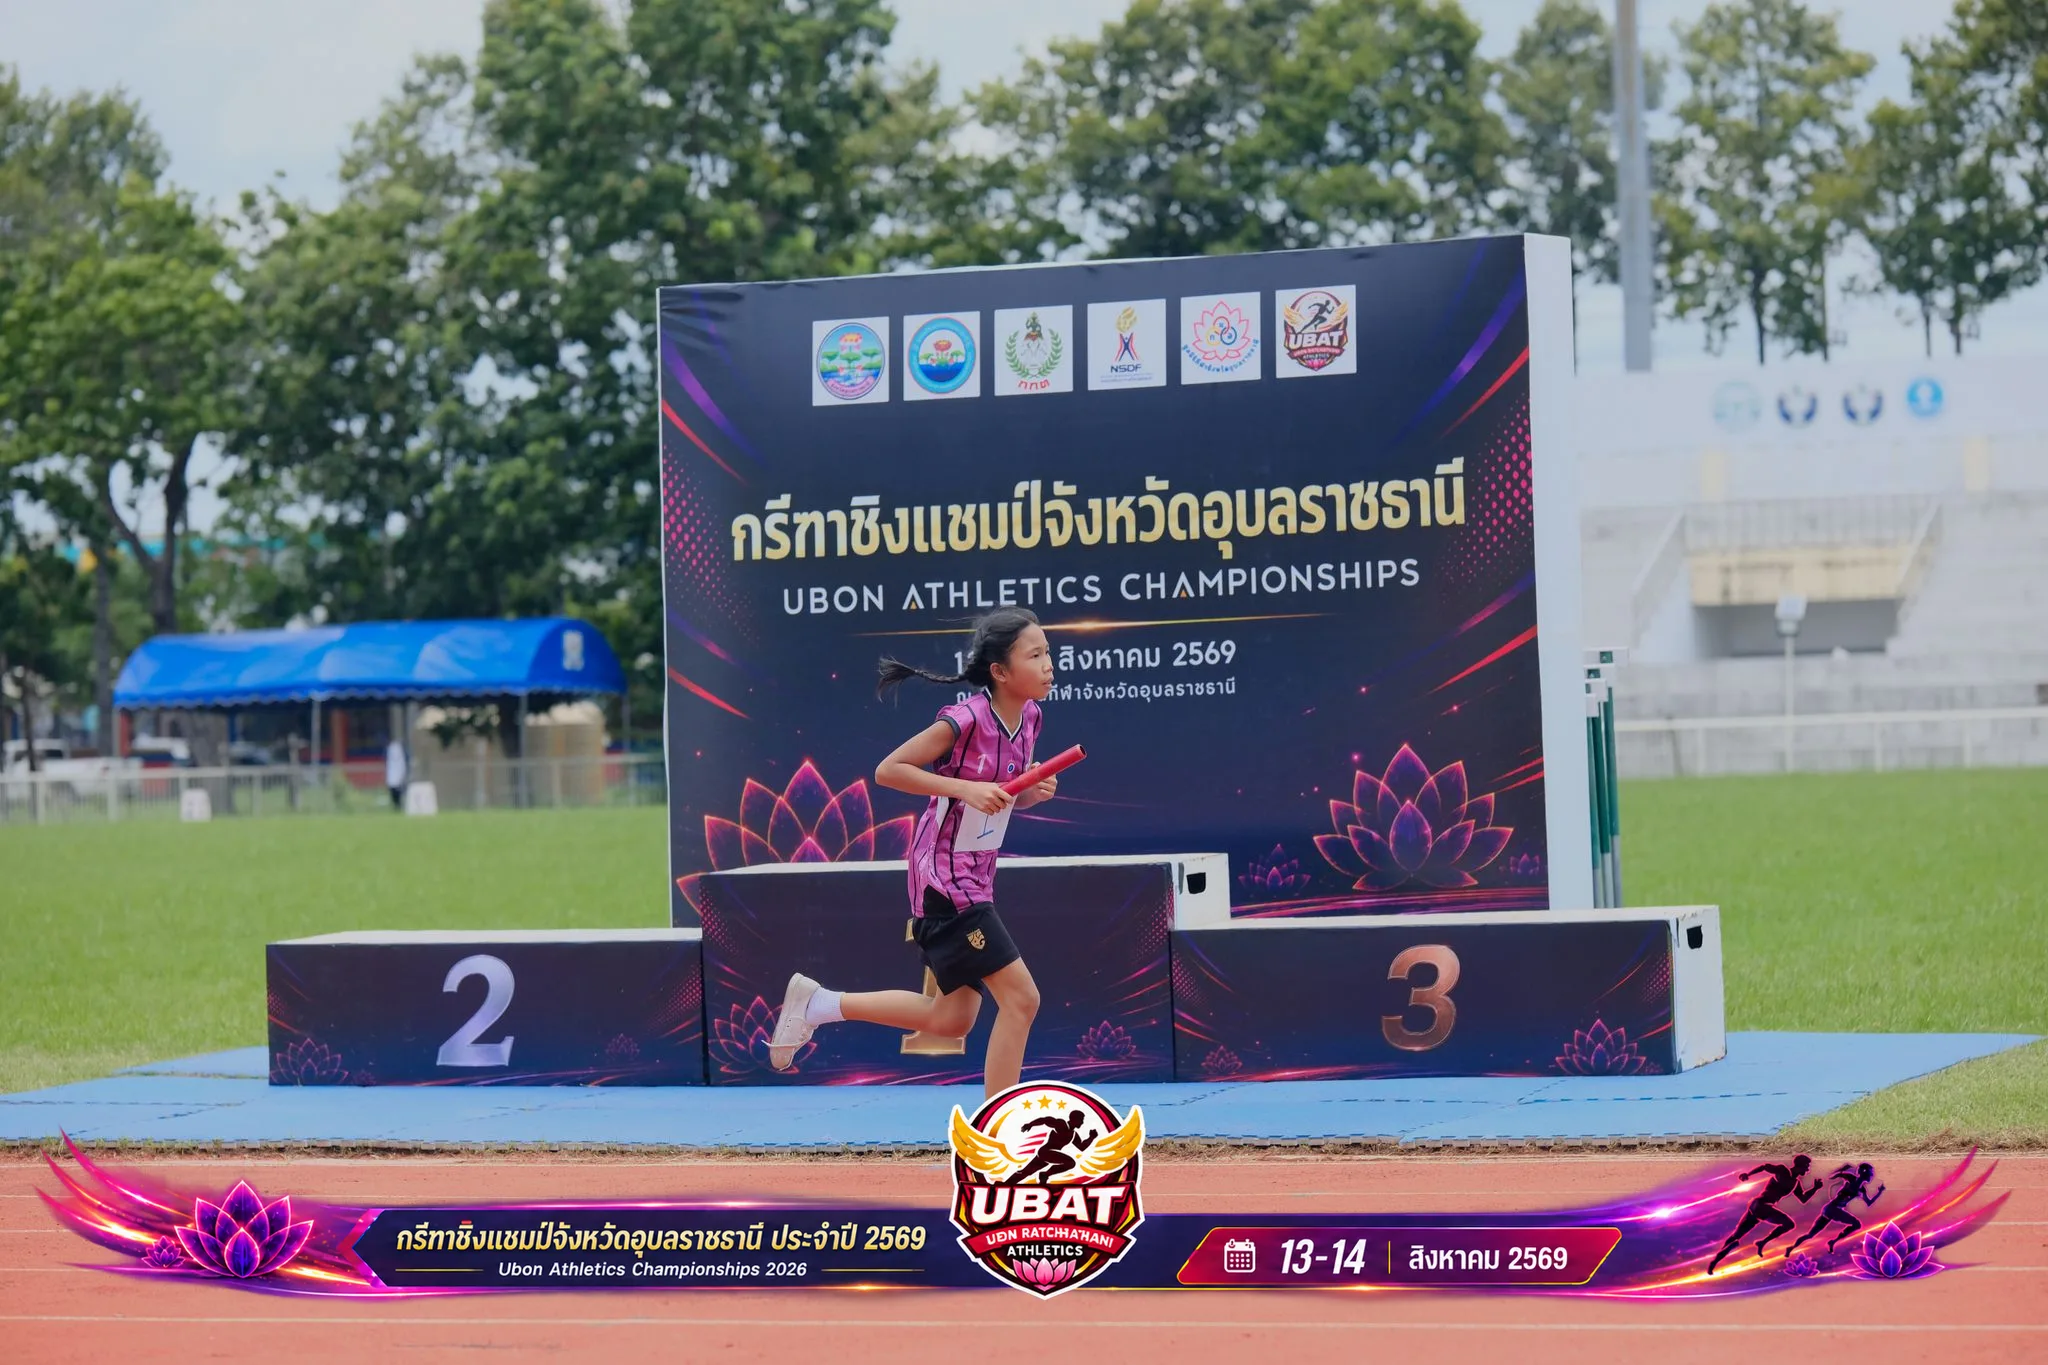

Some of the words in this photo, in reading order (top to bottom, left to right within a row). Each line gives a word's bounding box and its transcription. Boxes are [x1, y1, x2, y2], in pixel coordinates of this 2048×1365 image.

[1288, 330, 1344, 350] UBAT
[1110, 363, 1142, 373] NSDF
[731, 456, 1465, 561] กรีฑาชิงแชมป์จังหวัดอุบลราชธานี
[783, 584, 884, 615] UBON
[902, 575, 1102, 611] ATHLETICS
[1120, 558, 1420, 600] CHAMPIONSHIPS
[1058, 645, 1161, 671] สิงหาคม
[1172, 639, 1237, 667] 2569
[1038, 676, 1236, 703] กีฬาจังหวัดอุบลราชธานี
[436, 954, 515, 1067] 2
[1382, 944, 1460, 1052] 3
